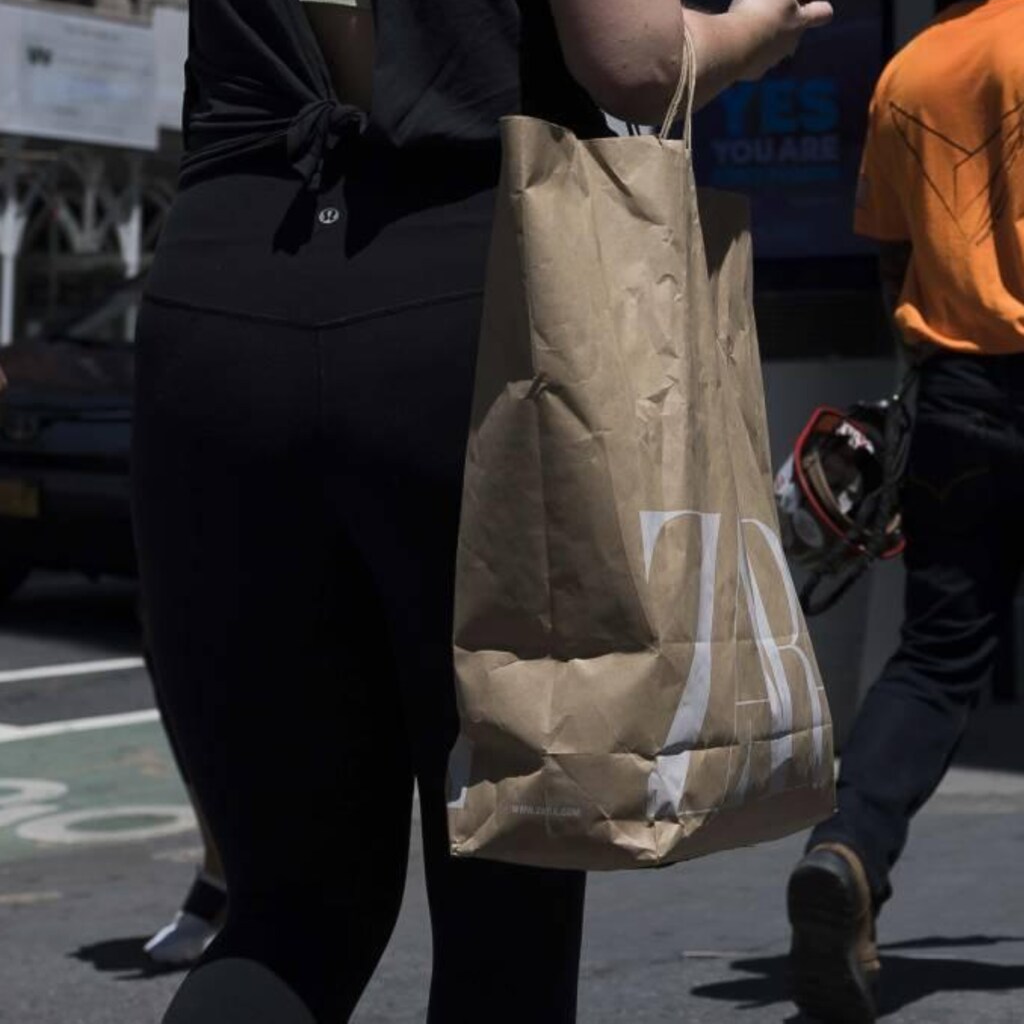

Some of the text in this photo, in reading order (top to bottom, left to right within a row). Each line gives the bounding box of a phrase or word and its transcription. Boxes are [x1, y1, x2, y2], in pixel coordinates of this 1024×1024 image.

[719, 77, 840, 137] YES
[711, 134, 841, 164] YOU ARE
